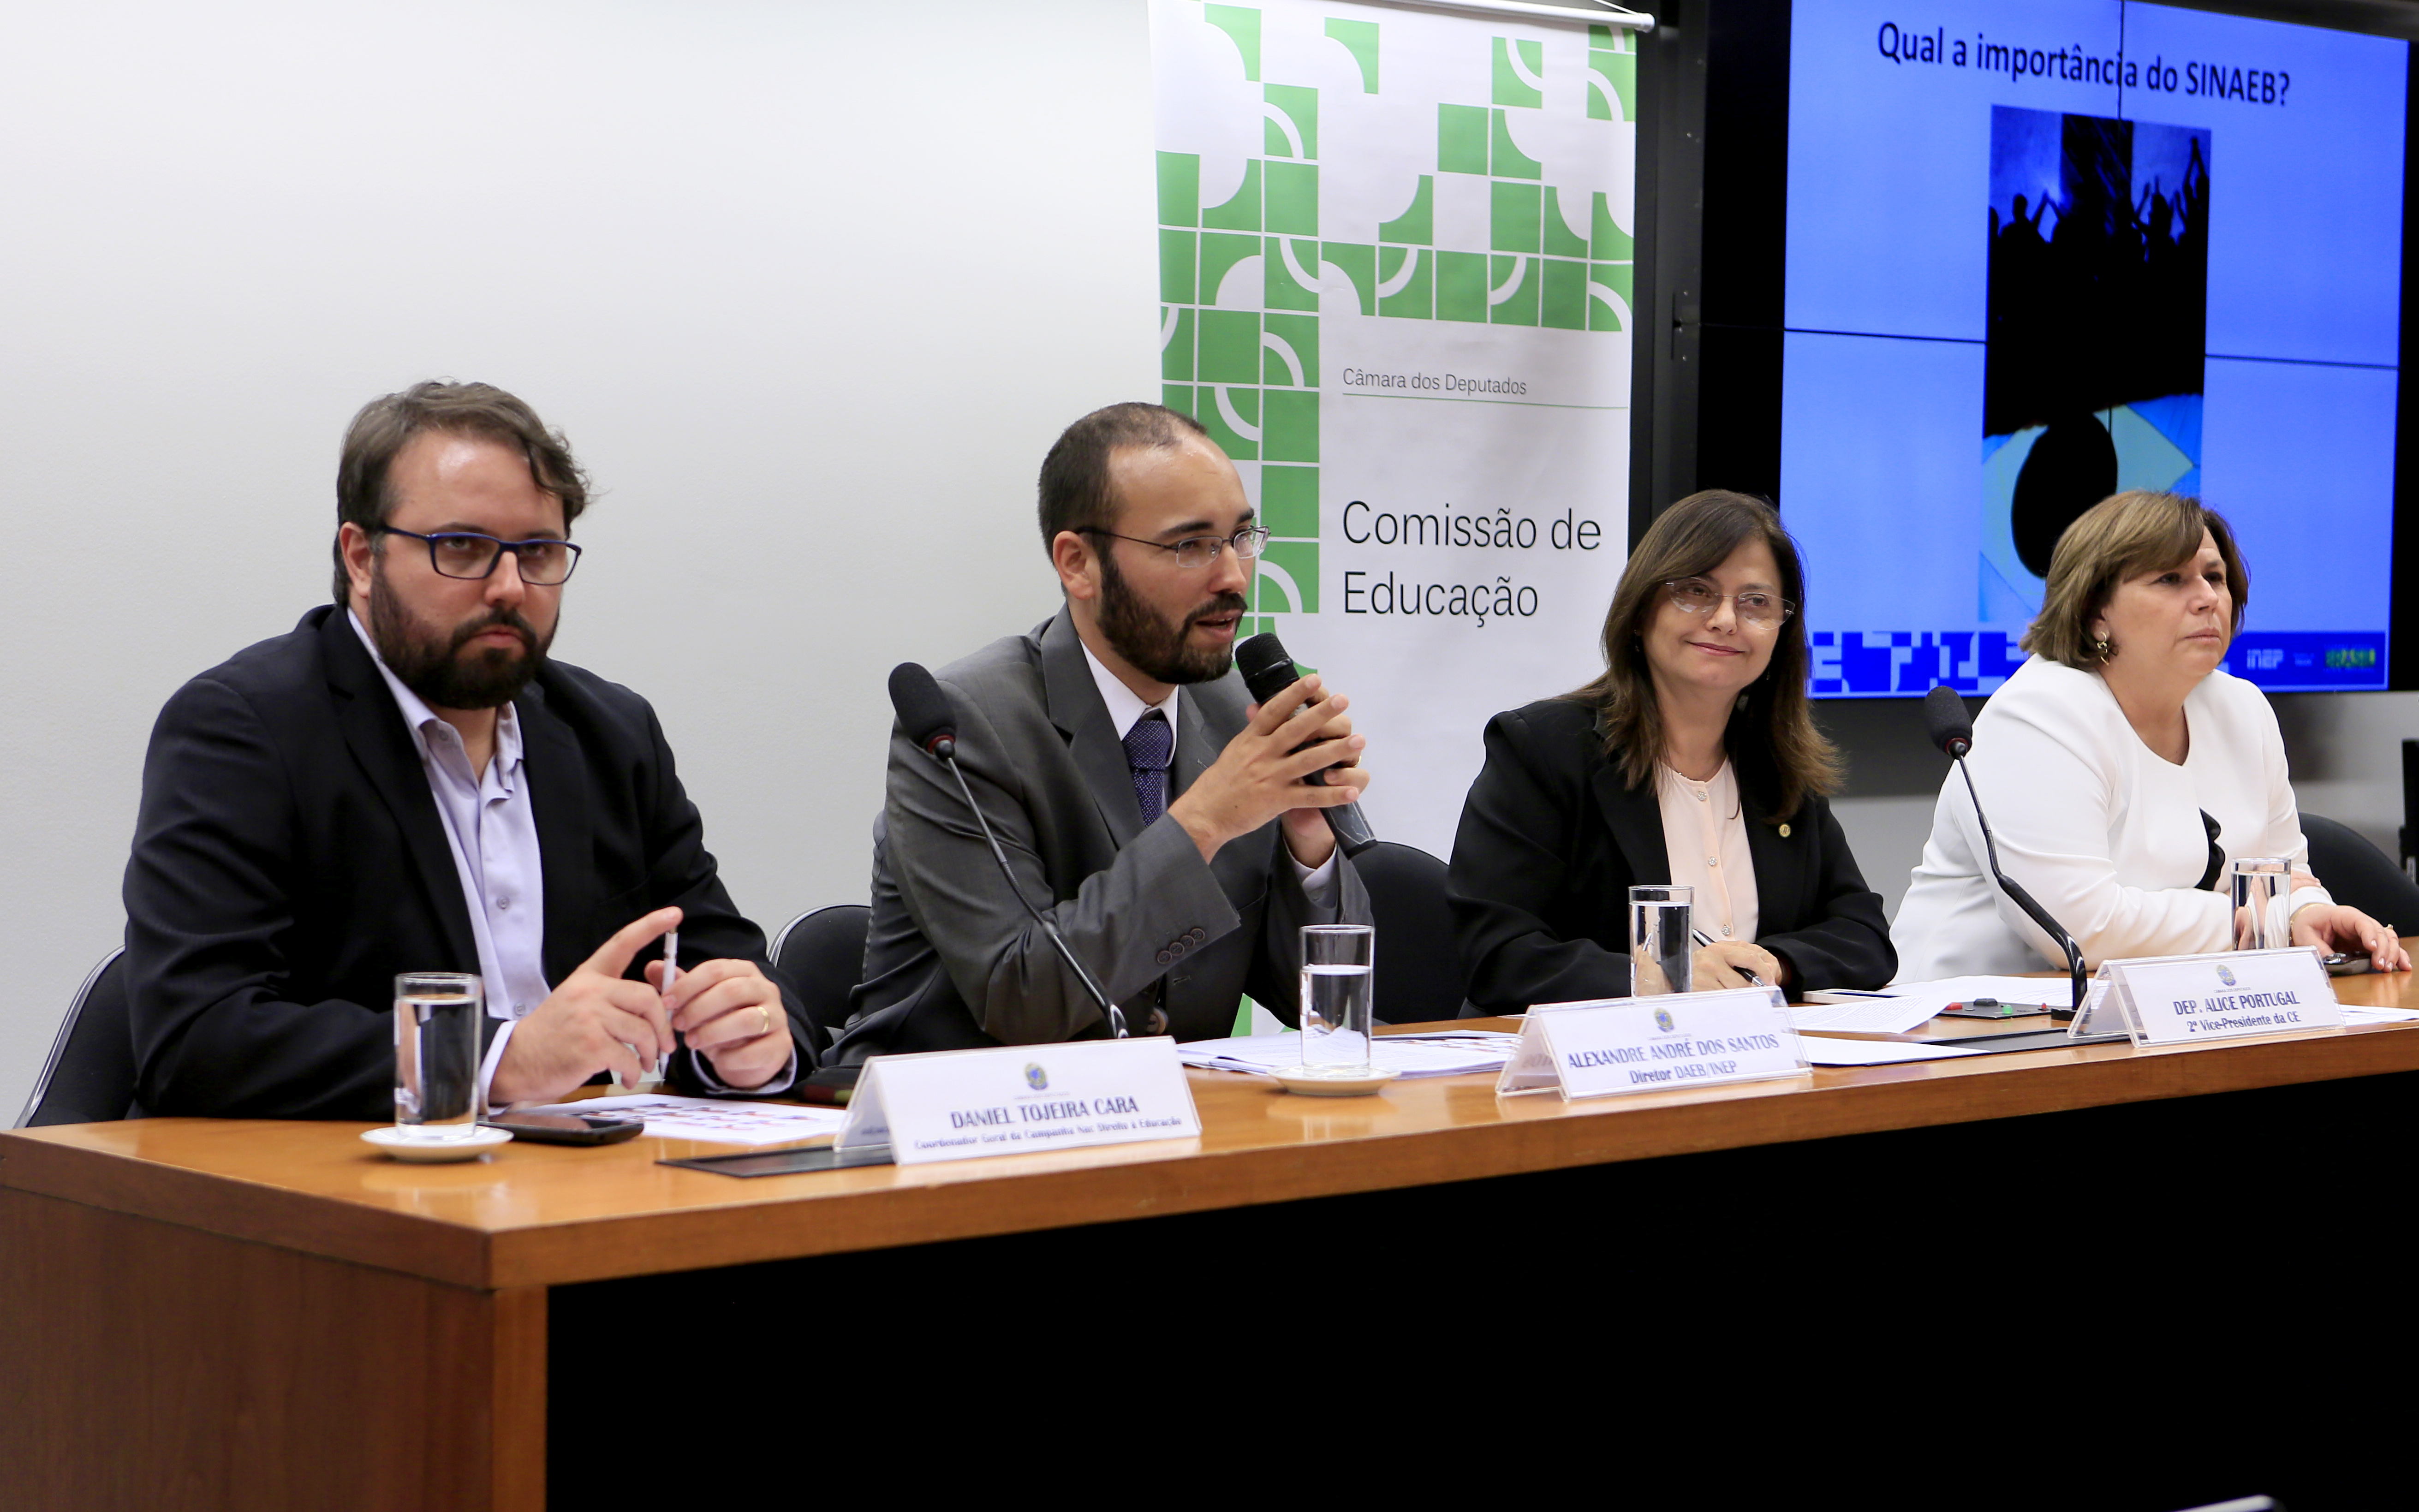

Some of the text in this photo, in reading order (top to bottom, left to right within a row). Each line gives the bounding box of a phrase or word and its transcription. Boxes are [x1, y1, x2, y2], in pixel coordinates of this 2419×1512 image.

[1878, 21, 2290, 107] Qual a importância do SINAEB?
[1343, 368, 1526, 396] Câmara dos Deputados
[1343, 500, 1602, 550] Comissão de
[1344, 571, 1538, 628] Educação
[2173, 991, 2300, 1015] DEP. ALICE PORTUGAL
[2199, 1015, 2271, 1031] Vice-Presidente
[2273, 1013, 2286, 1024] da
[2287, 1011, 2301, 1022] CE
[1568, 1046, 1648, 1067] ALEXANDRE
[1650, 1037, 1696, 1060] ANDRÉ
[1696, 1039, 1726, 1055] DOS
[1727, 1034, 1779, 1052] SANTOS
[1629, 1060, 1736, 1083] Diretor DAEB/INEP
[951, 1095, 1139, 1128] DANIEL TOJEIRA CARA
